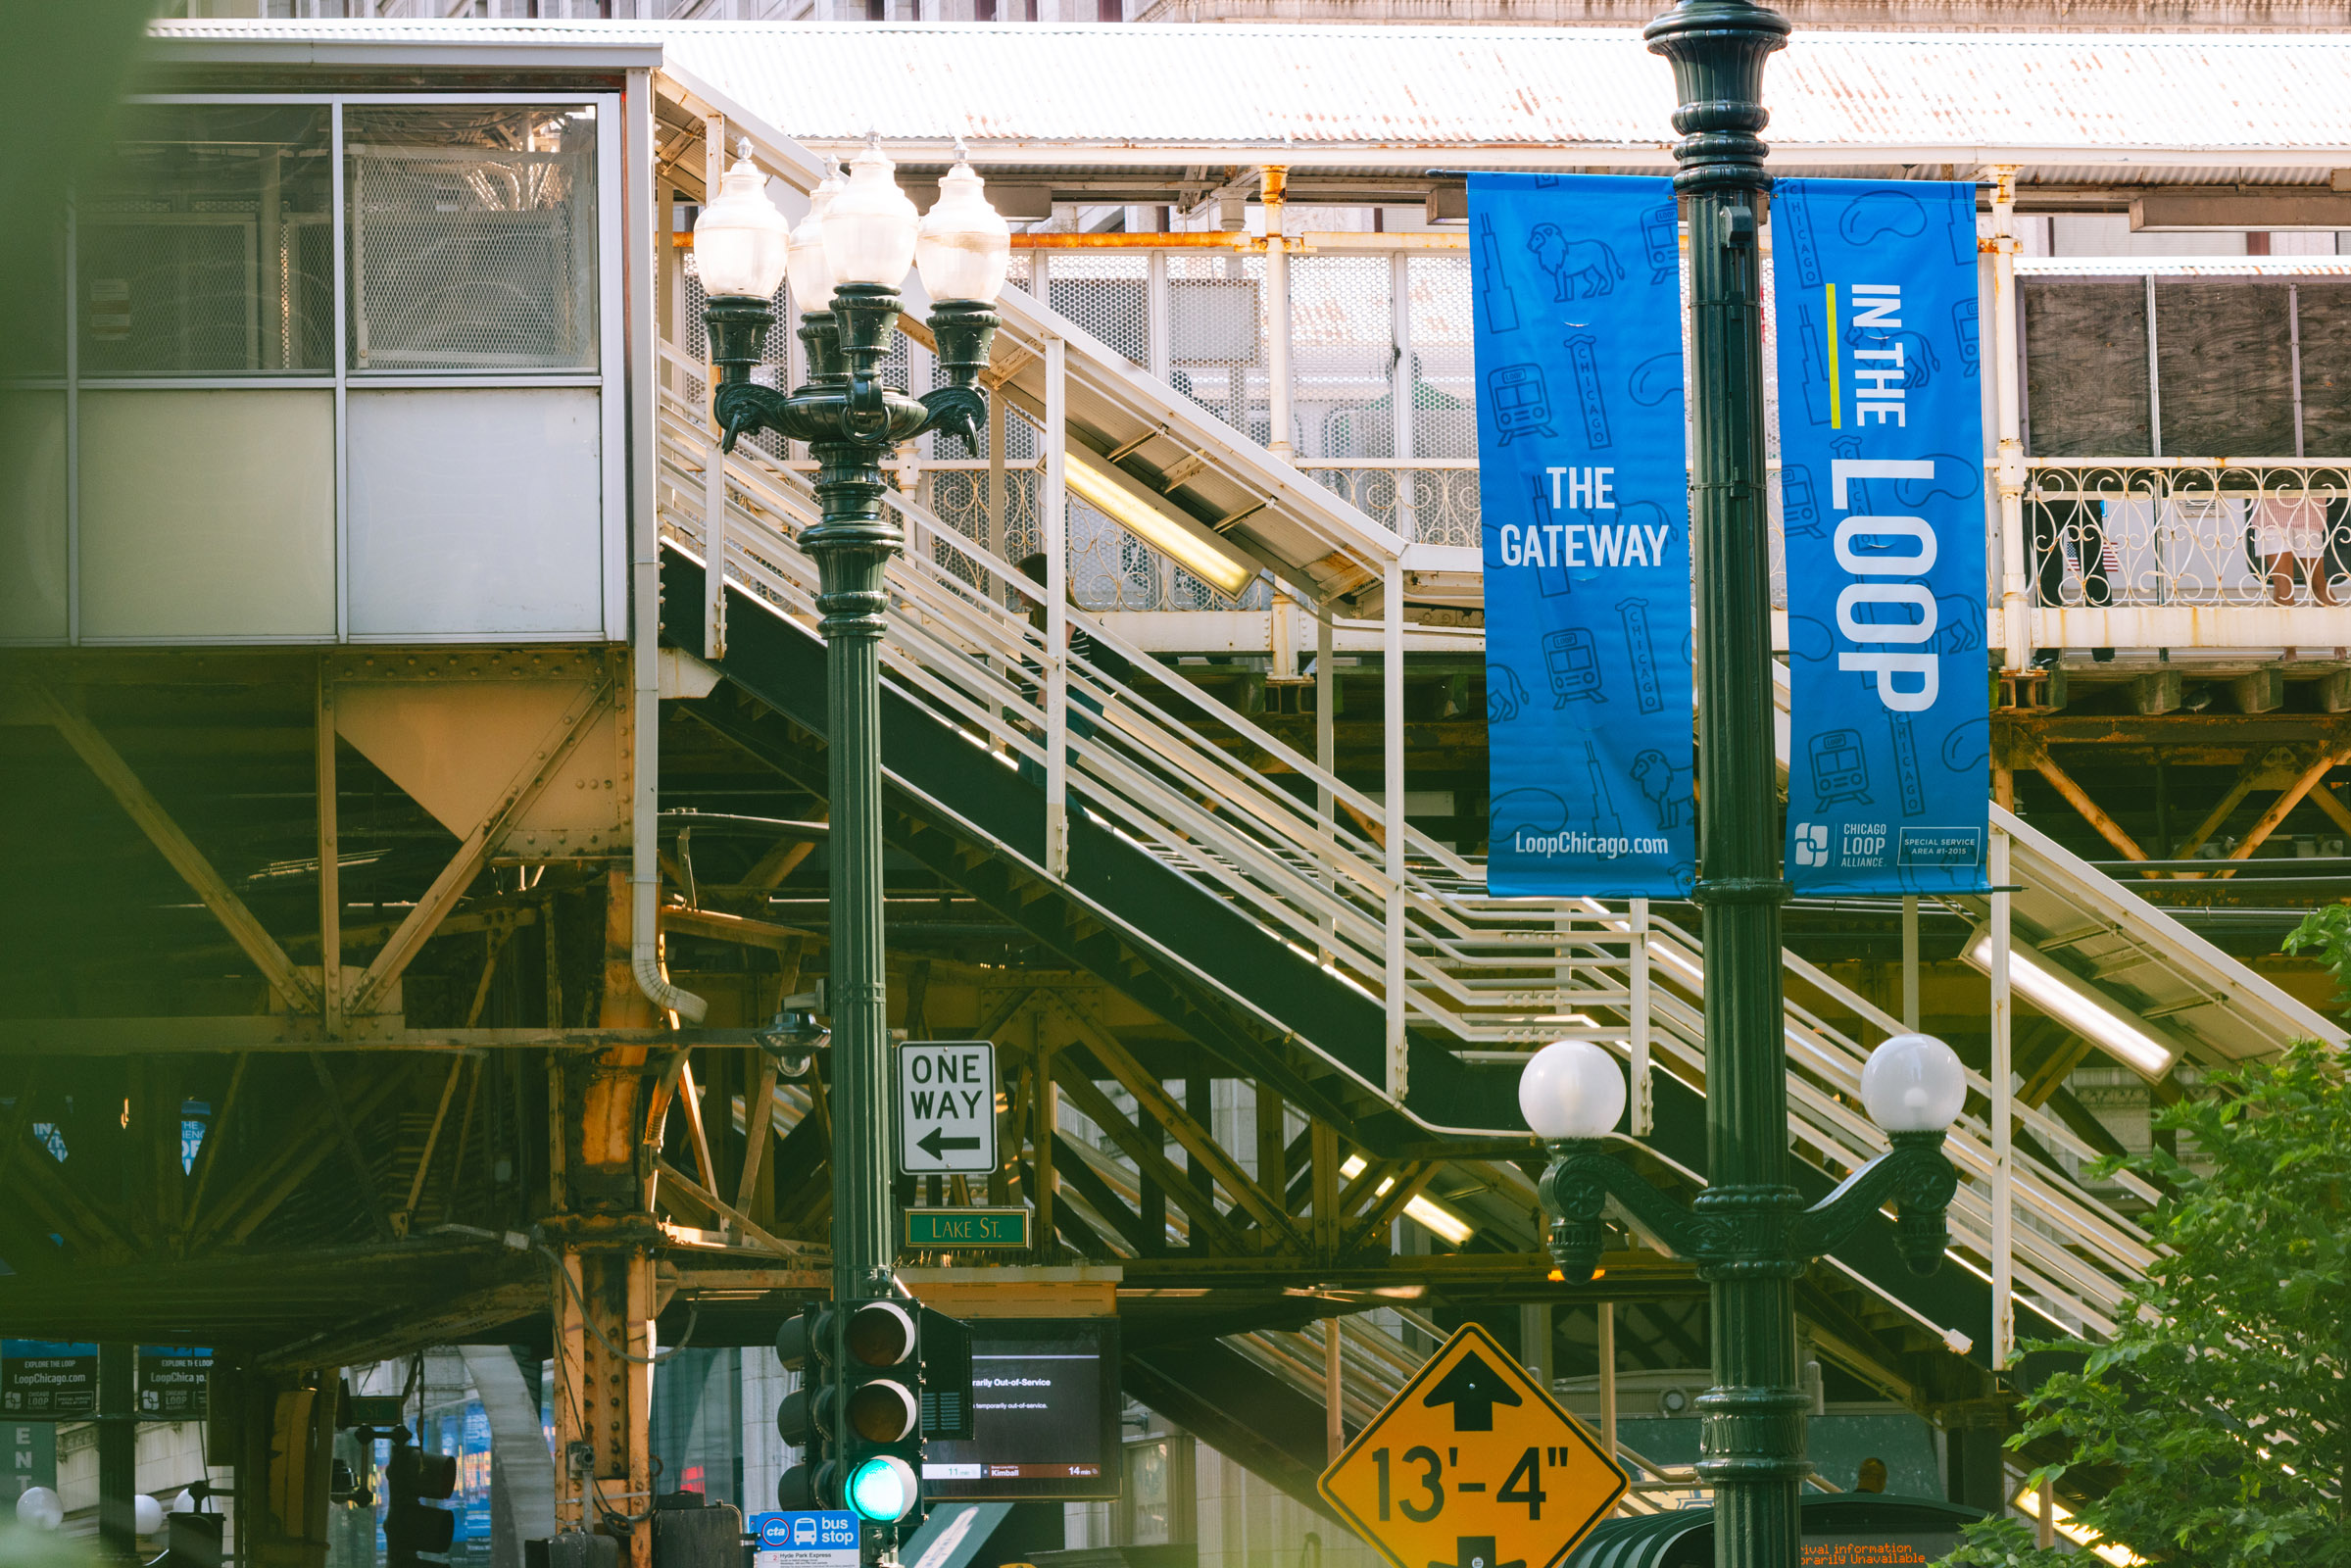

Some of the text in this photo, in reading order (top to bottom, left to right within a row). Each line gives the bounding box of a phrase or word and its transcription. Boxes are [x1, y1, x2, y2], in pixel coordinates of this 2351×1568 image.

[1789, 184, 1816, 281] CHICAGO
[1578, 347, 1604, 443] CHICAGO
[1545, 466, 1616, 510] THE
[1844, 449, 1872, 544] CICAO
[1831, 284, 1939, 712] IN THE LOOP
[1500, 523, 1669, 567] GATEWAY
[1630, 611, 1655, 708] CHICAGO
[1895, 713, 1918, 809] CHICAGO
[1843, 823, 1886, 835] CHICAGO
[1515, 831, 1669, 859] LoopChicago.com
[1842, 837, 1886, 856] LOOP
[911, 1054, 981, 1084] ONE
[909, 1090, 983, 1120] WAY
[162, 1359, 186, 1368] EXPLORE
[14, 1373, 86, 1386] LoopChicago.com
[994, 1378, 1052, 1387] Out-of-Service
[948, 1467, 958, 1476] 11
[1068, 1466, 1080, 1475] 14
[766, 1527, 786, 1537] cta
[822, 1517, 848, 1530] bus
[821, 1531, 855, 1545] stop
[1834, 1543, 1912, 1554] information
[1850, 1553, 1926, 1565] Unavailable
